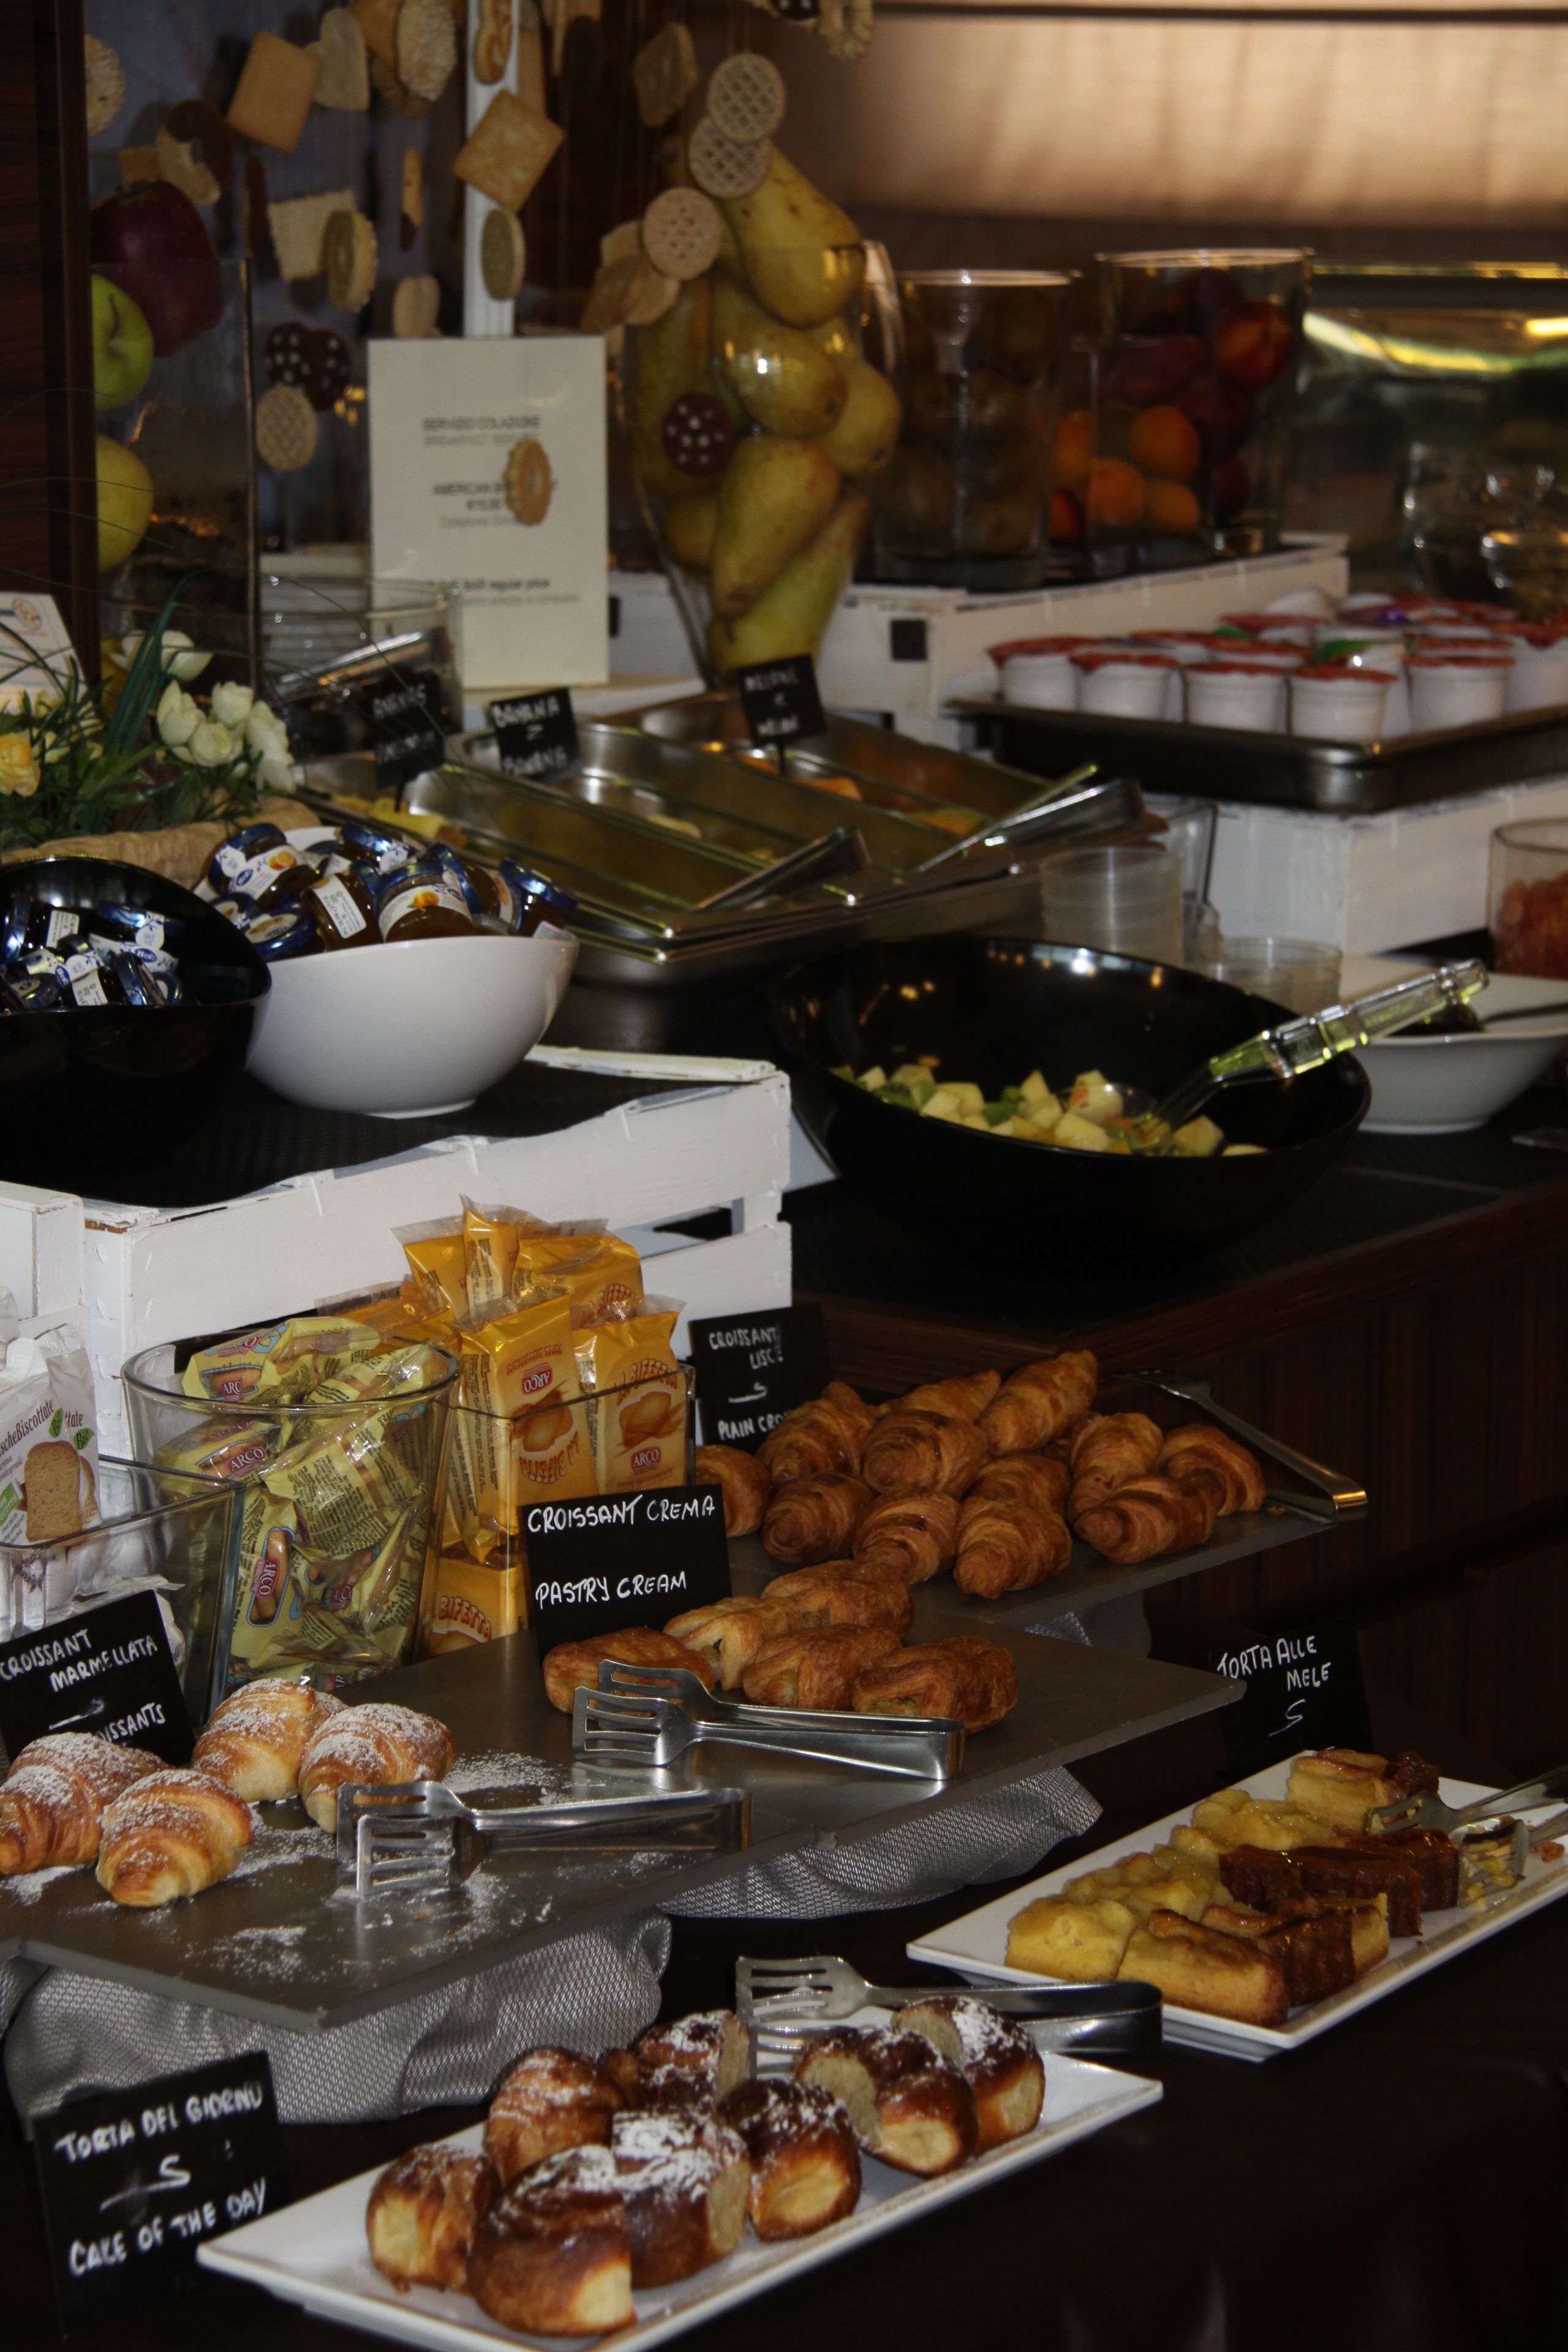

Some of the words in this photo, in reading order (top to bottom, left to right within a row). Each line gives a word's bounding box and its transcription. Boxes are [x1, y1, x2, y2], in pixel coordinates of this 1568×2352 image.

[709, 1327, 777, 1350] CROISSANT
[224, 1381, 241, 1395] ARC
[524, 1371, 551, 1393] ARCO
[718, 1417, 755, 1441] PLAIN
[231, 1447, 264, 1471] ARCO
[633, 1449, 660, 1468] ARCO
[527, 1494, 643, 1533] CROISSANT
[646, 1495, 715, 1521] CREMA
[258, 1559, 279, 1596] ARCO
[535, 1577, 610, 1610] PASTRY
[616, 1571, 687, 1599] CREAM
[439, 1596, 492, 1641] BIFETTA
[0, 1628, 92, 1681] CROISSANT
[50, 1635, 158, 1692] MARMELLATA
[1216, 1645, 1273, 1679] TORTA
[1276, 1635, 1317, 1665] ALLE
[1287, 1661, 1331, 1691] MELE
[54, 2118, 135, 2163] TORTA
[69, 2231, 127, 2277] CAKE
[137, 2215, 164, 2253] OF
[170, 2201, 217, 2238] THE
[226, 2177, 266, 2220] DAY
